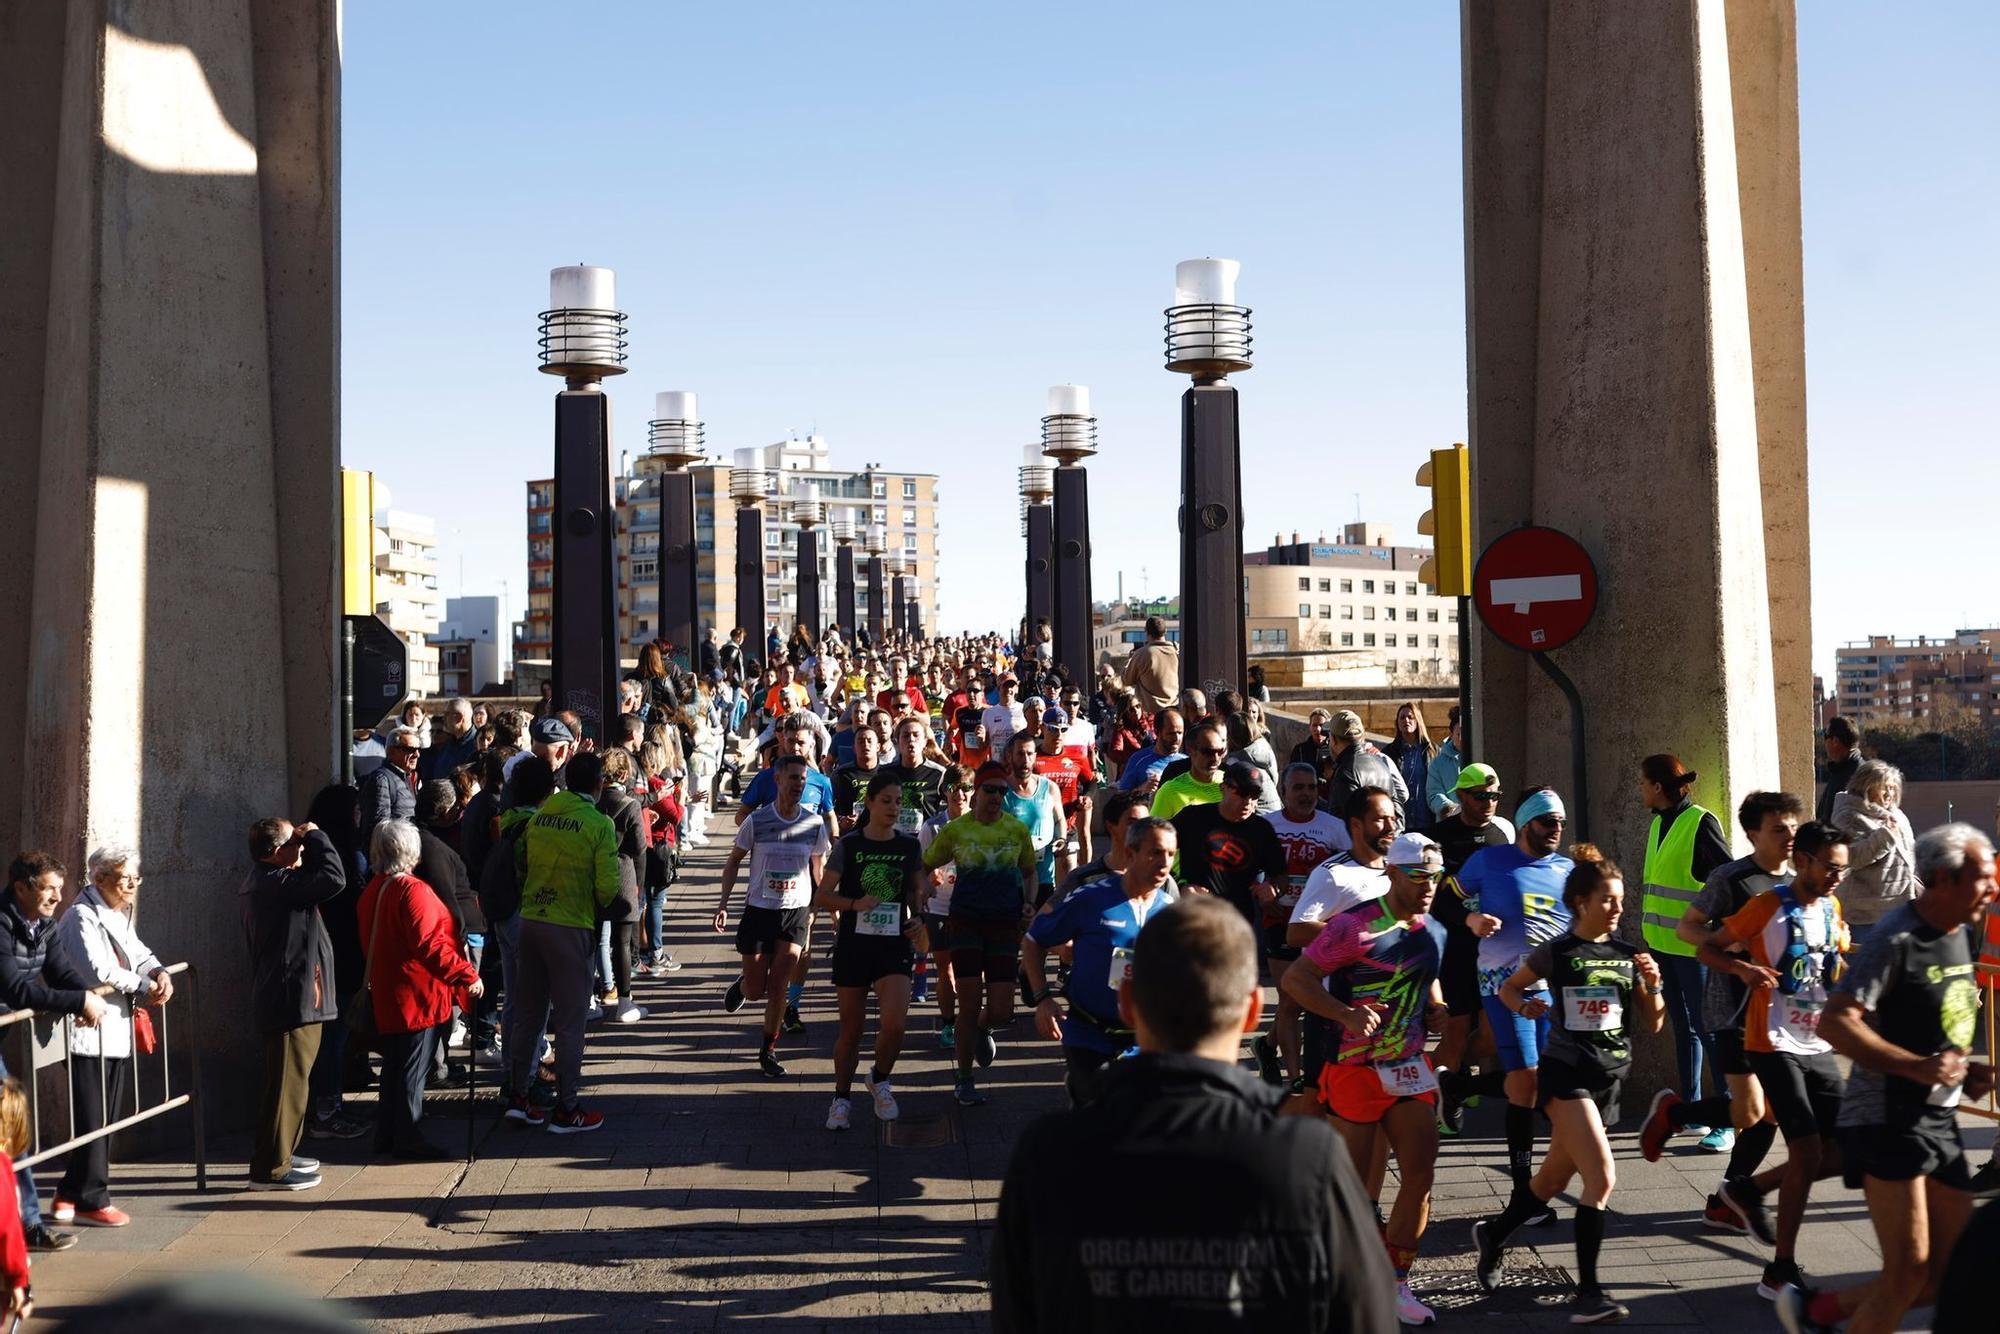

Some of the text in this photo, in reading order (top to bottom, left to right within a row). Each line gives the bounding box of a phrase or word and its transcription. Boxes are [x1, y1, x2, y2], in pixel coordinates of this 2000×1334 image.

[768, 879, 797, 889] 3312
[863, 912, 894, 924] 3381
[1577, 999, 1609, 1014] 746
[1391, 1066, 1420, 1082] 749
[1088, 1269, 1119, 1296] DE
